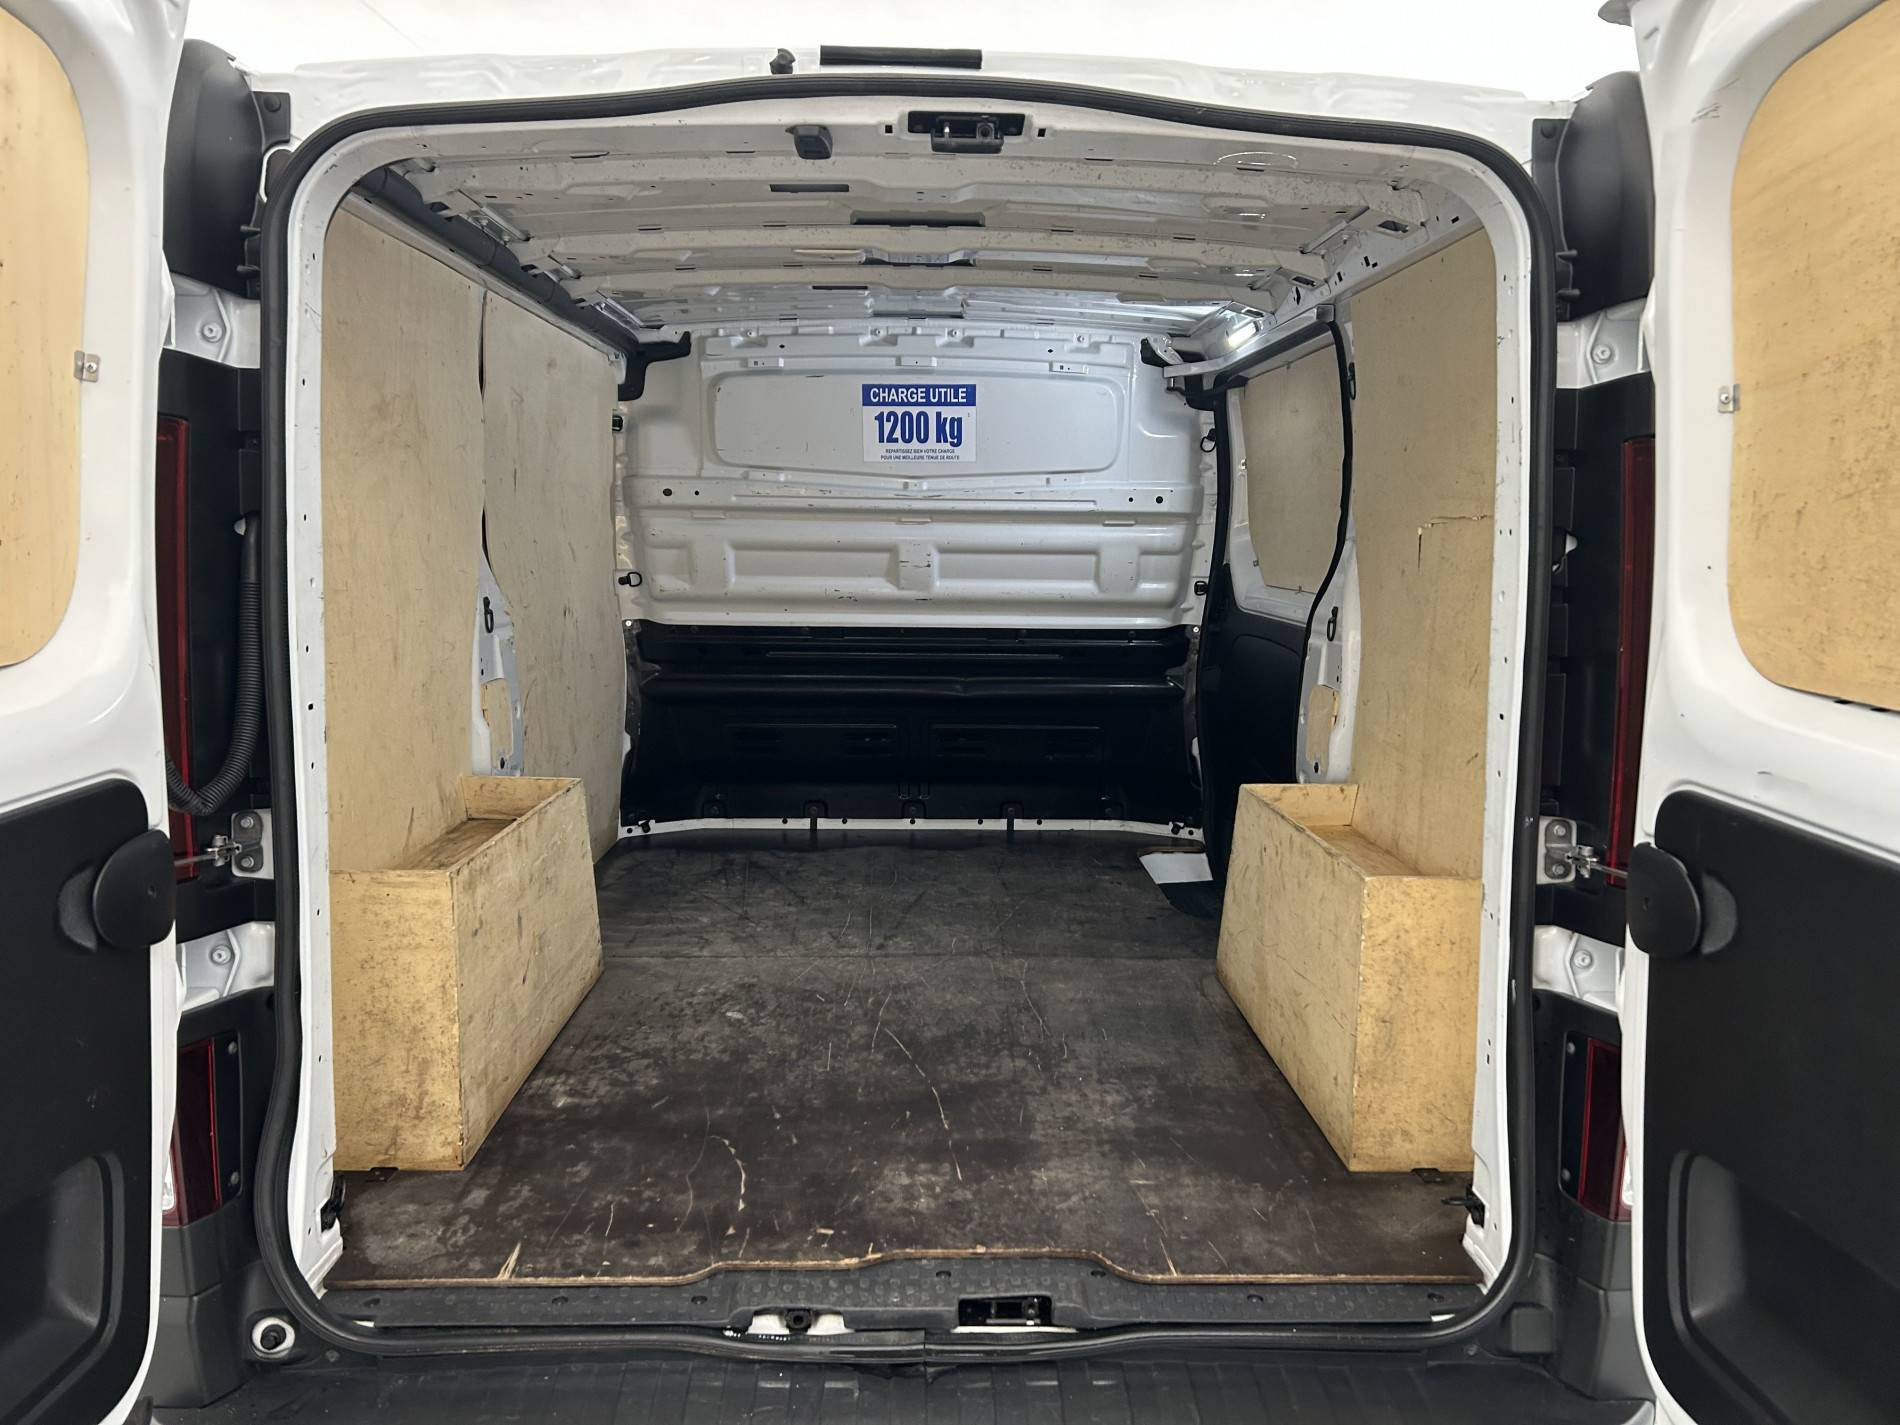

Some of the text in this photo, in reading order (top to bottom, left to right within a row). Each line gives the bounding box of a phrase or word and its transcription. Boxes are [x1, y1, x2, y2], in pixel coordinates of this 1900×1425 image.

[870, 387, 967, 403] CHARGE UTILE
[874, 410, 963, 447] 1200 kg
